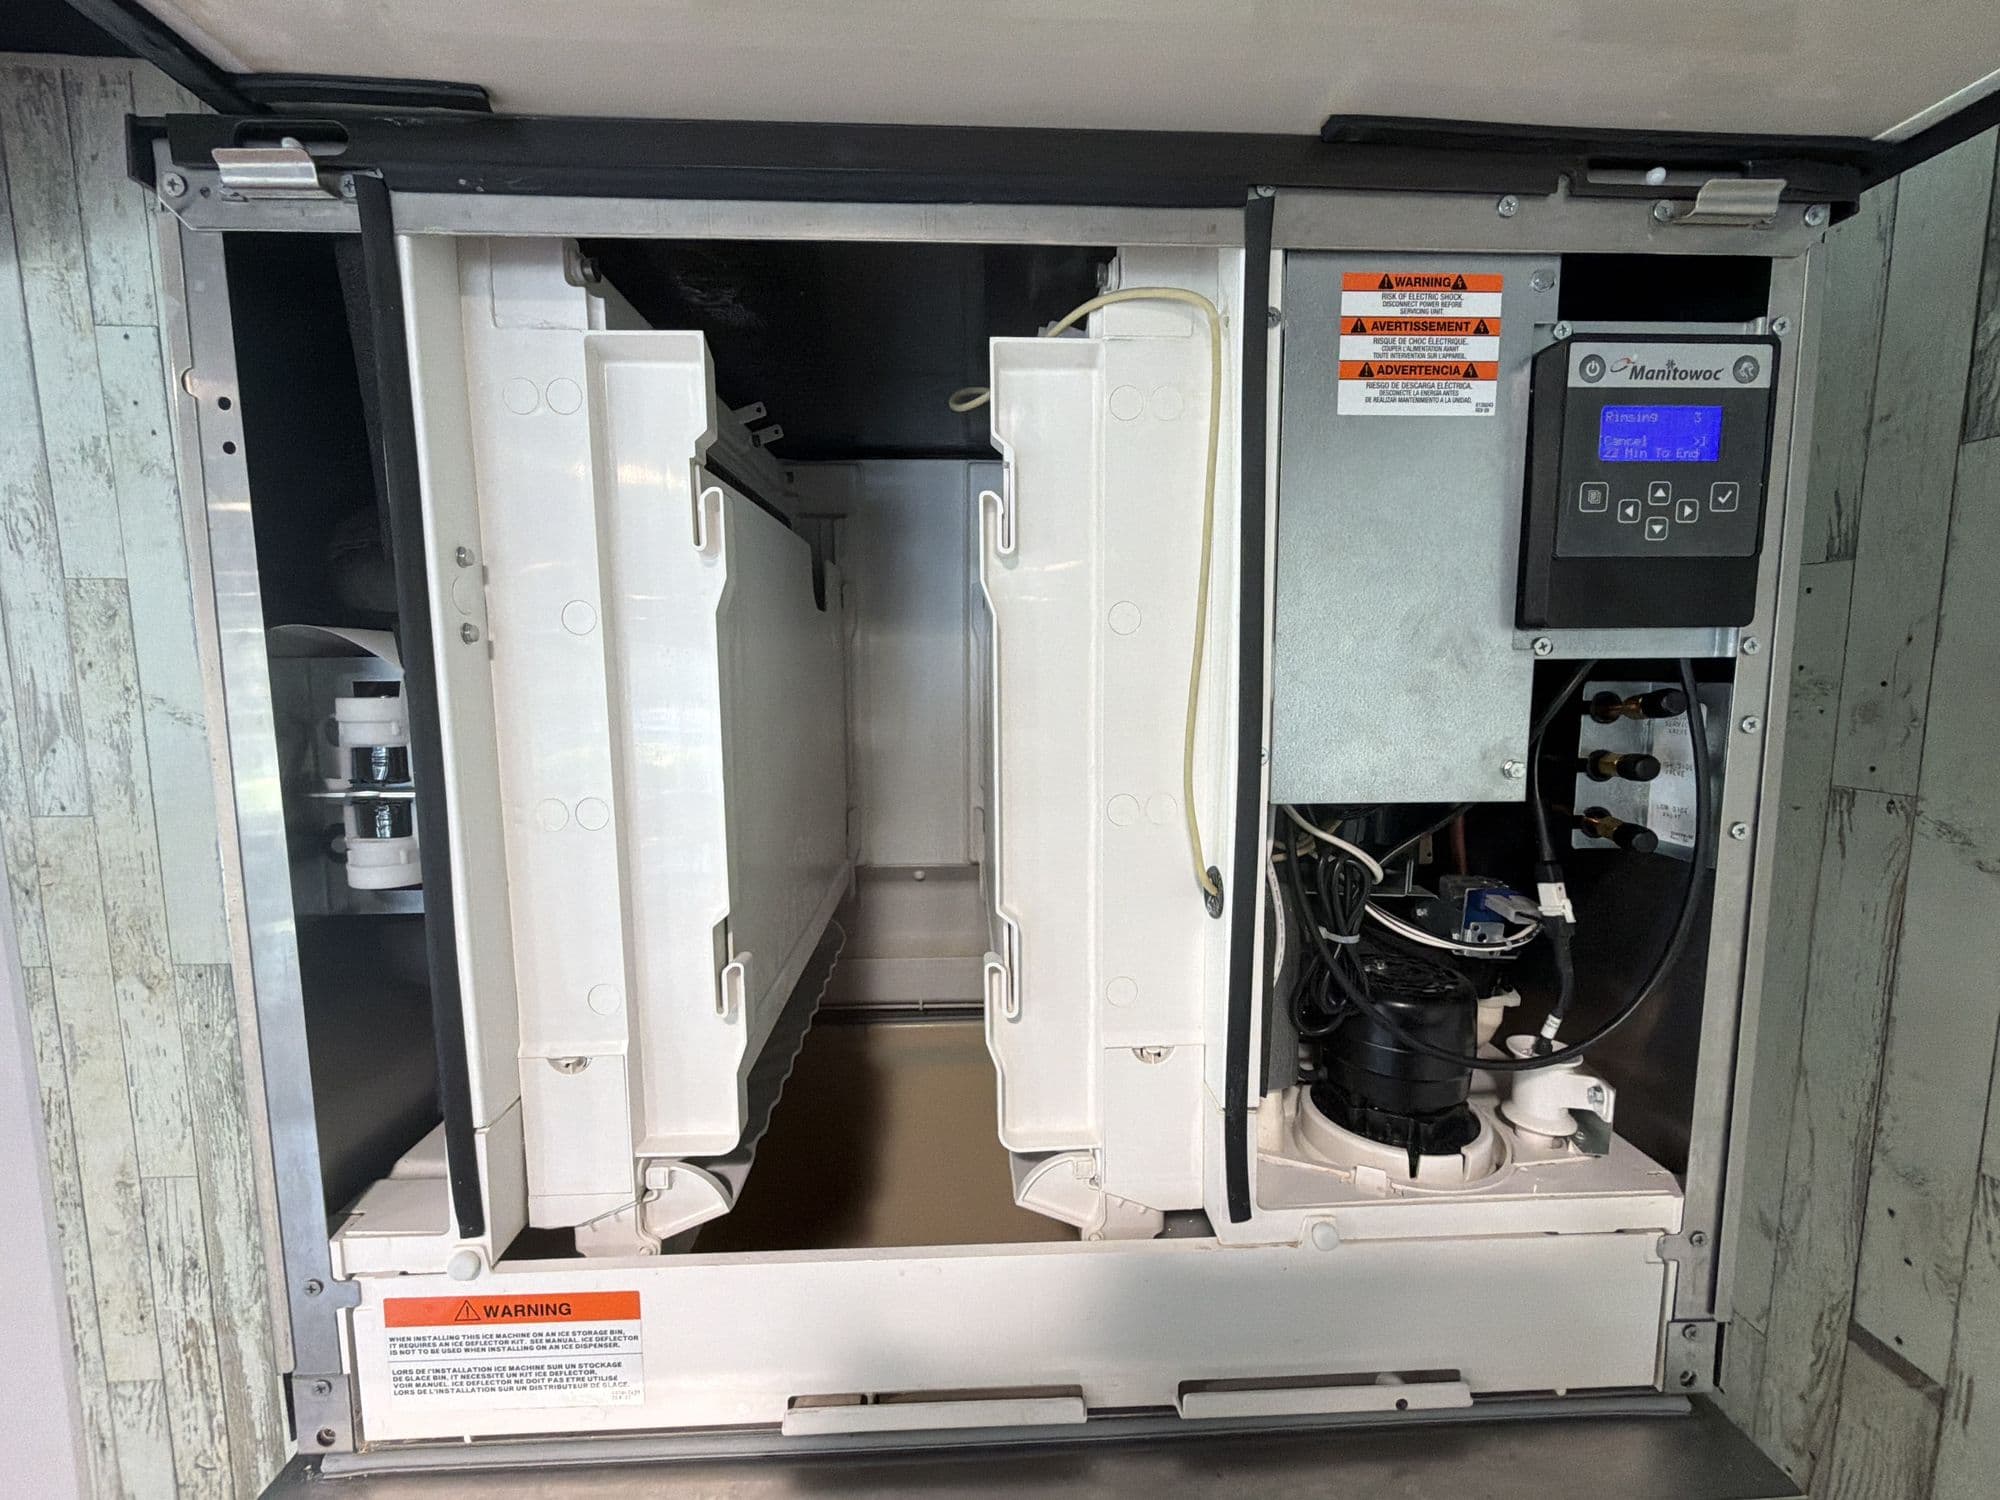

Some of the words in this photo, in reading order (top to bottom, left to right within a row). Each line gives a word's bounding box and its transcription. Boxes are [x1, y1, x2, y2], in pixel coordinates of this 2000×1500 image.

[1395, 277, 1450, 288] WARNING
[1382, 293, 1397, 301] RISK
[1399, 293, 1407, 301] OF
[1409, 293, 1438, 301] ELECTRIC
[1371, 321, 1470, 332] AVERTISSEMENT
[1373, 337, 1396, 345] RISQUE
[1398, 337, 1406, 345] DE
[1408, 337, 1426, 345] CHOC
[1377, 365, 1461, 376] ADVERTENCIA
[1629, 360, 1724, 380] Manitowoc
[1366, 381, 1389, 389] RIESGO
[1391, 381, 1400, 389] DE
[1402, 381, 1435, 389] DESCARGA
[1605, 411, 1658, 423] Rinsing
[1603, 435, 1647, 447] Cancel
[1625, 448, 1648, 459] Min
[1655, 448, 1670, 459] To
[1676, 447, 1700, 459] End
[484, 1303, 572, 1318] WARNING
[414, 1334, 460, 1342] INSTALLING
[495, 1331, 530, 1339] MACHINE
[465, 1339, 509, 1347] DEFLECTOR
[488, 1345, 535, 1353] INSTALLING
[508, 1364, 544, 1372] MACHINE
[578, 1361, 622, 1369] STOCKAGE
[466, 1379, 512, 1387] DEFLECTOR
[530, 1383, 588, 1391] DISTRIBUTEUR
